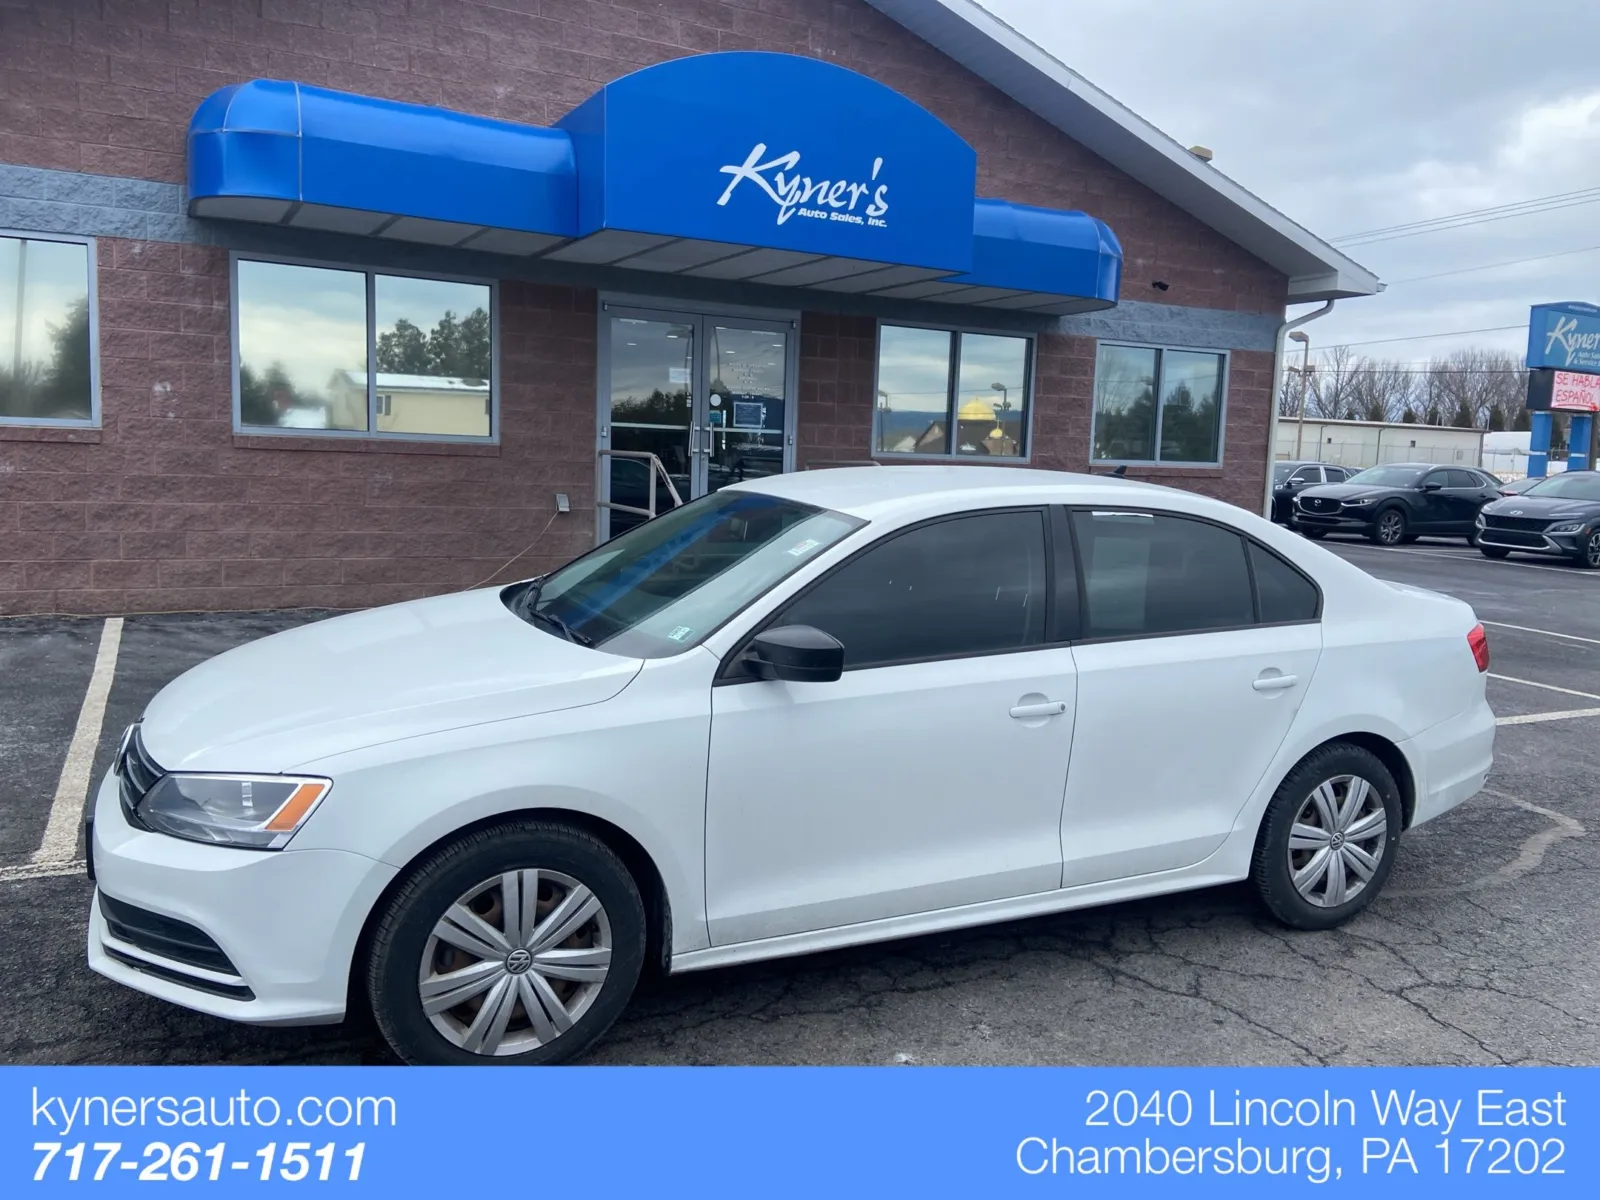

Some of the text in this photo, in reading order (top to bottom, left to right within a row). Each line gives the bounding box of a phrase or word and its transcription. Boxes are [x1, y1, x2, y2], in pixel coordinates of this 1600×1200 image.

[716, 142, 889, 226] Kyner's
[797, 207, 888, 228] Auto Sales, Inc.
[1556, 373, 1569, 385] SE
[1555, 389, 1596, 405] ESPAÑOL
